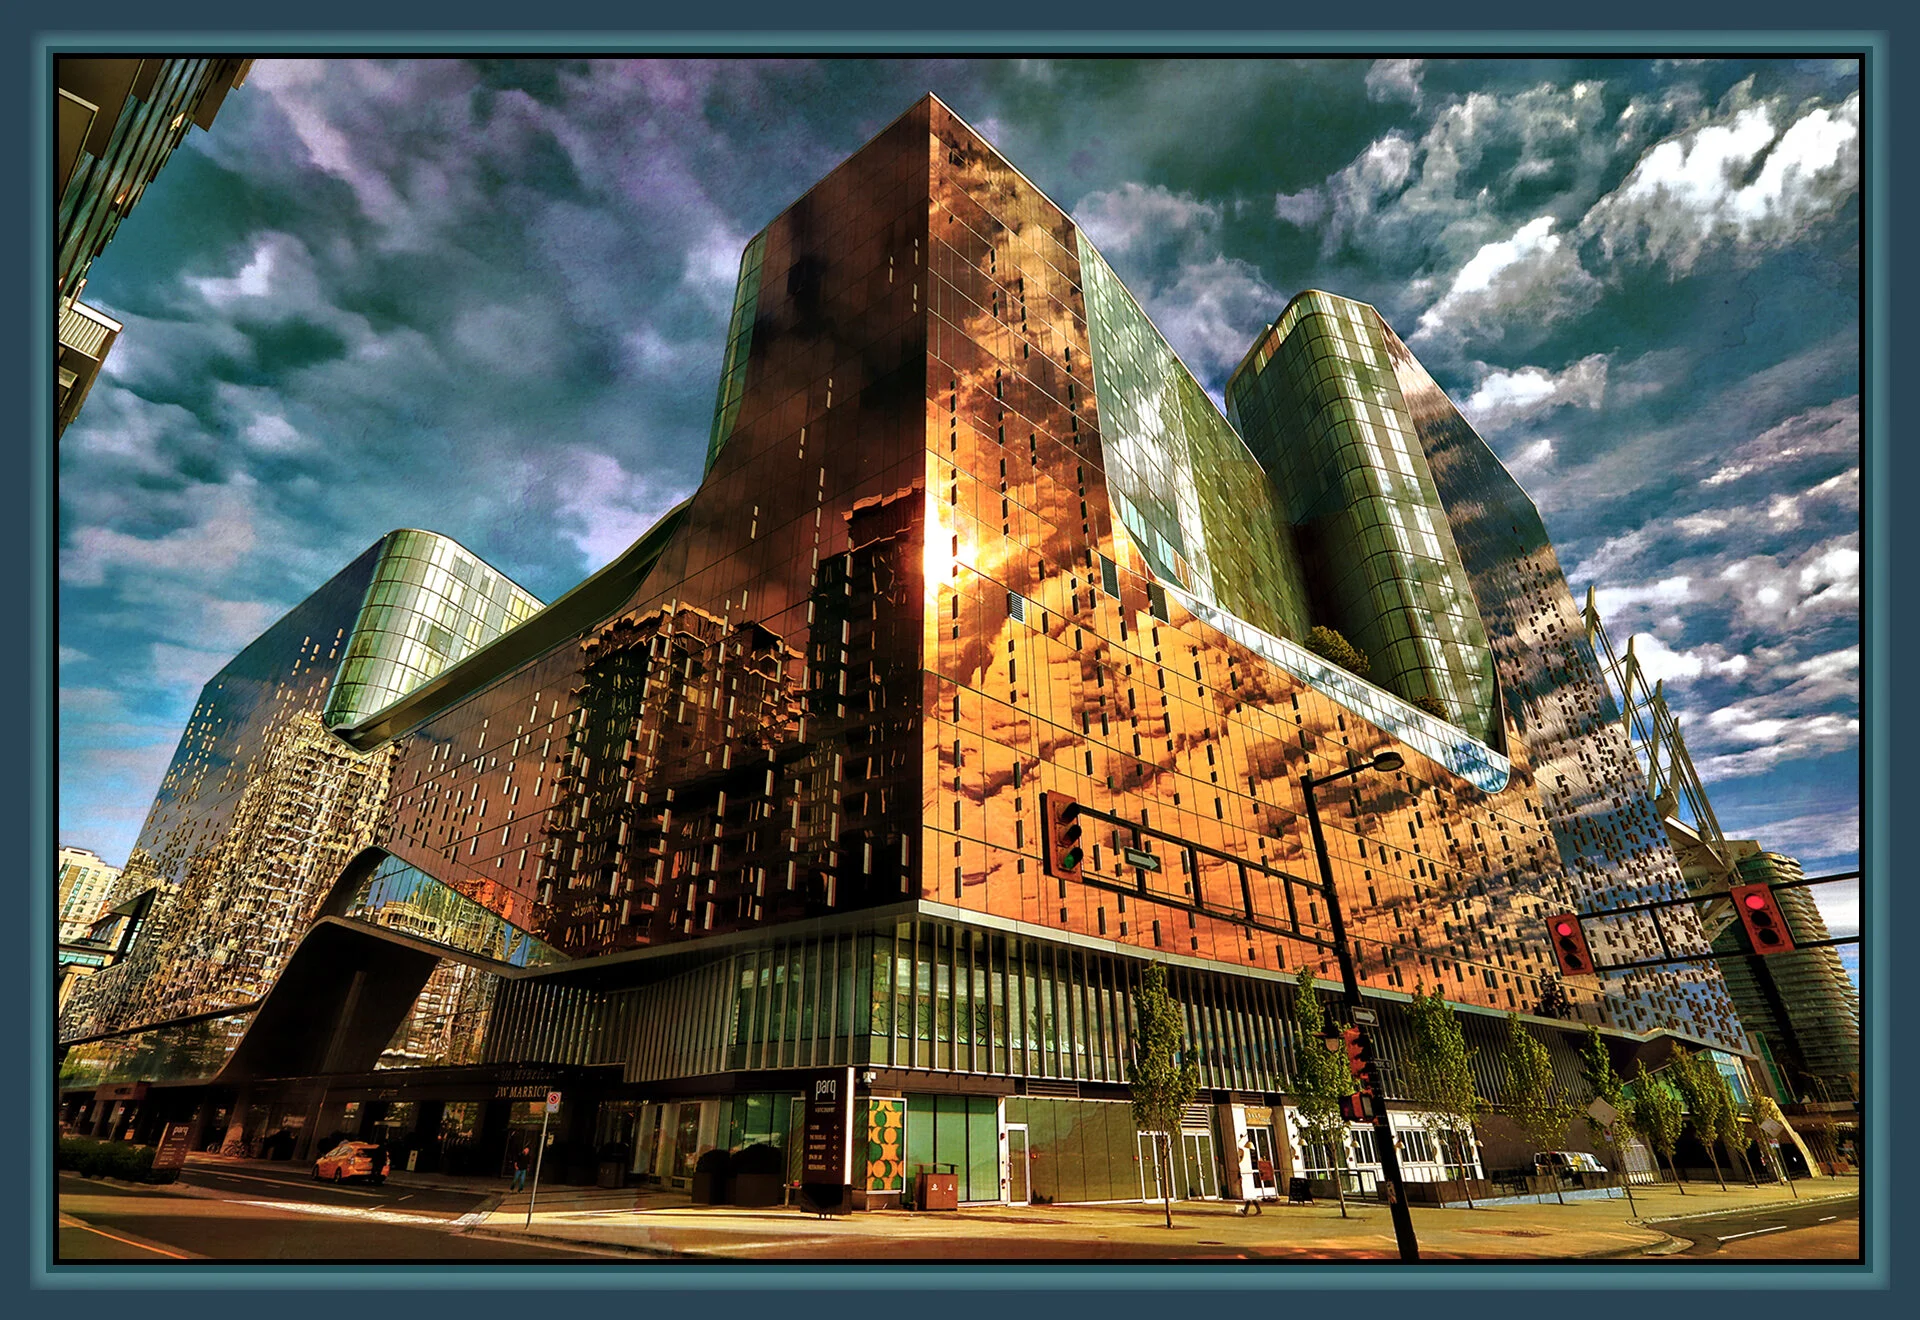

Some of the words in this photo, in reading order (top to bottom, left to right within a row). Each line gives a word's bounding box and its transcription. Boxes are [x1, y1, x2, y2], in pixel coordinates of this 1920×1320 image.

[495, 1086, 509, 1098] JW
[815, 1079, 836, 1101] parq
[172, 1126, 189, 1136] parq
